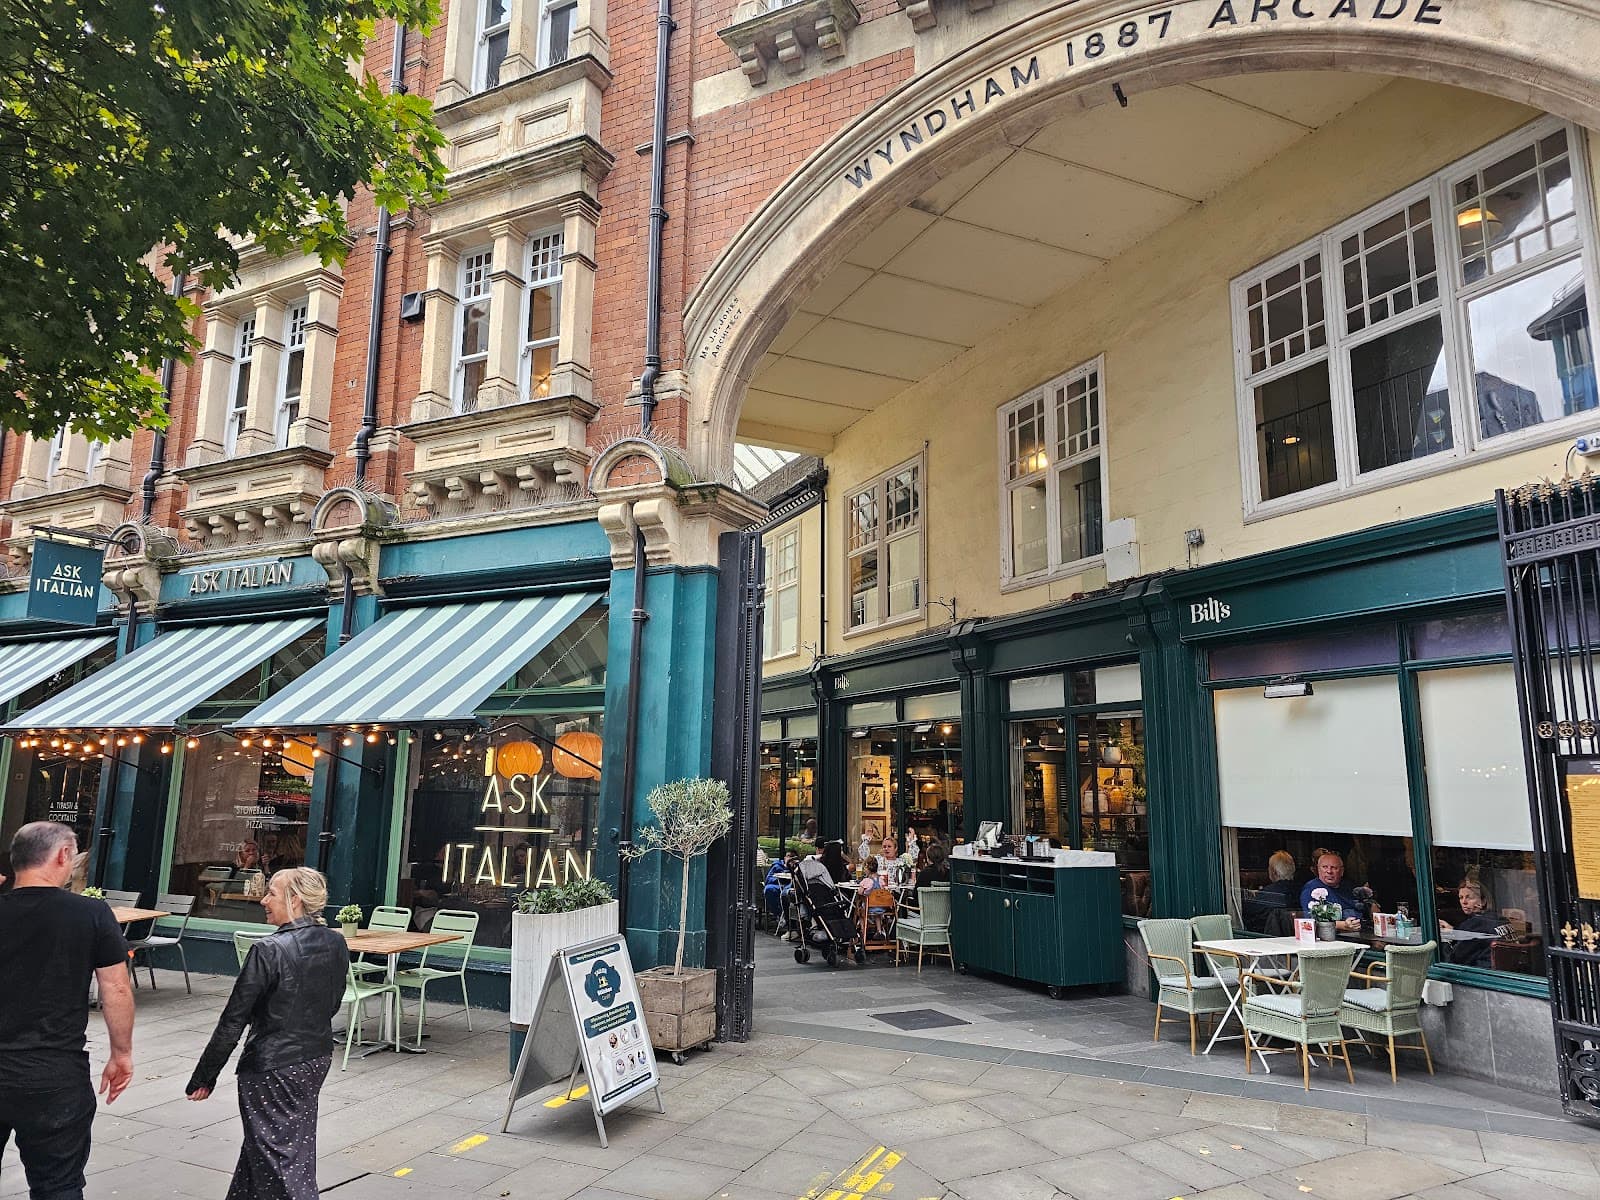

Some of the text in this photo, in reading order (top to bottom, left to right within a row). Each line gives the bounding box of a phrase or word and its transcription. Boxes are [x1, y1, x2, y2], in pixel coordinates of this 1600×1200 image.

[844, 0, 1443, 189] WYNDHAM 1887 ARCADE
[53, 563, 82, 580] ASK
[190, 562, 293, 594] ASK ITALIAN
[36, 578, 94, 599] ITALIAN
[1190, 597, 1231, 624] Bill's
[482, 773, 551, 814] ASK
[49, 813, 77, 823] COCKTAILS
[236, 805, 276, 815] STONEBAKED
[246, 820, 263, 829] PIZZA
[442, 844, 592, 888] ITALIAN
